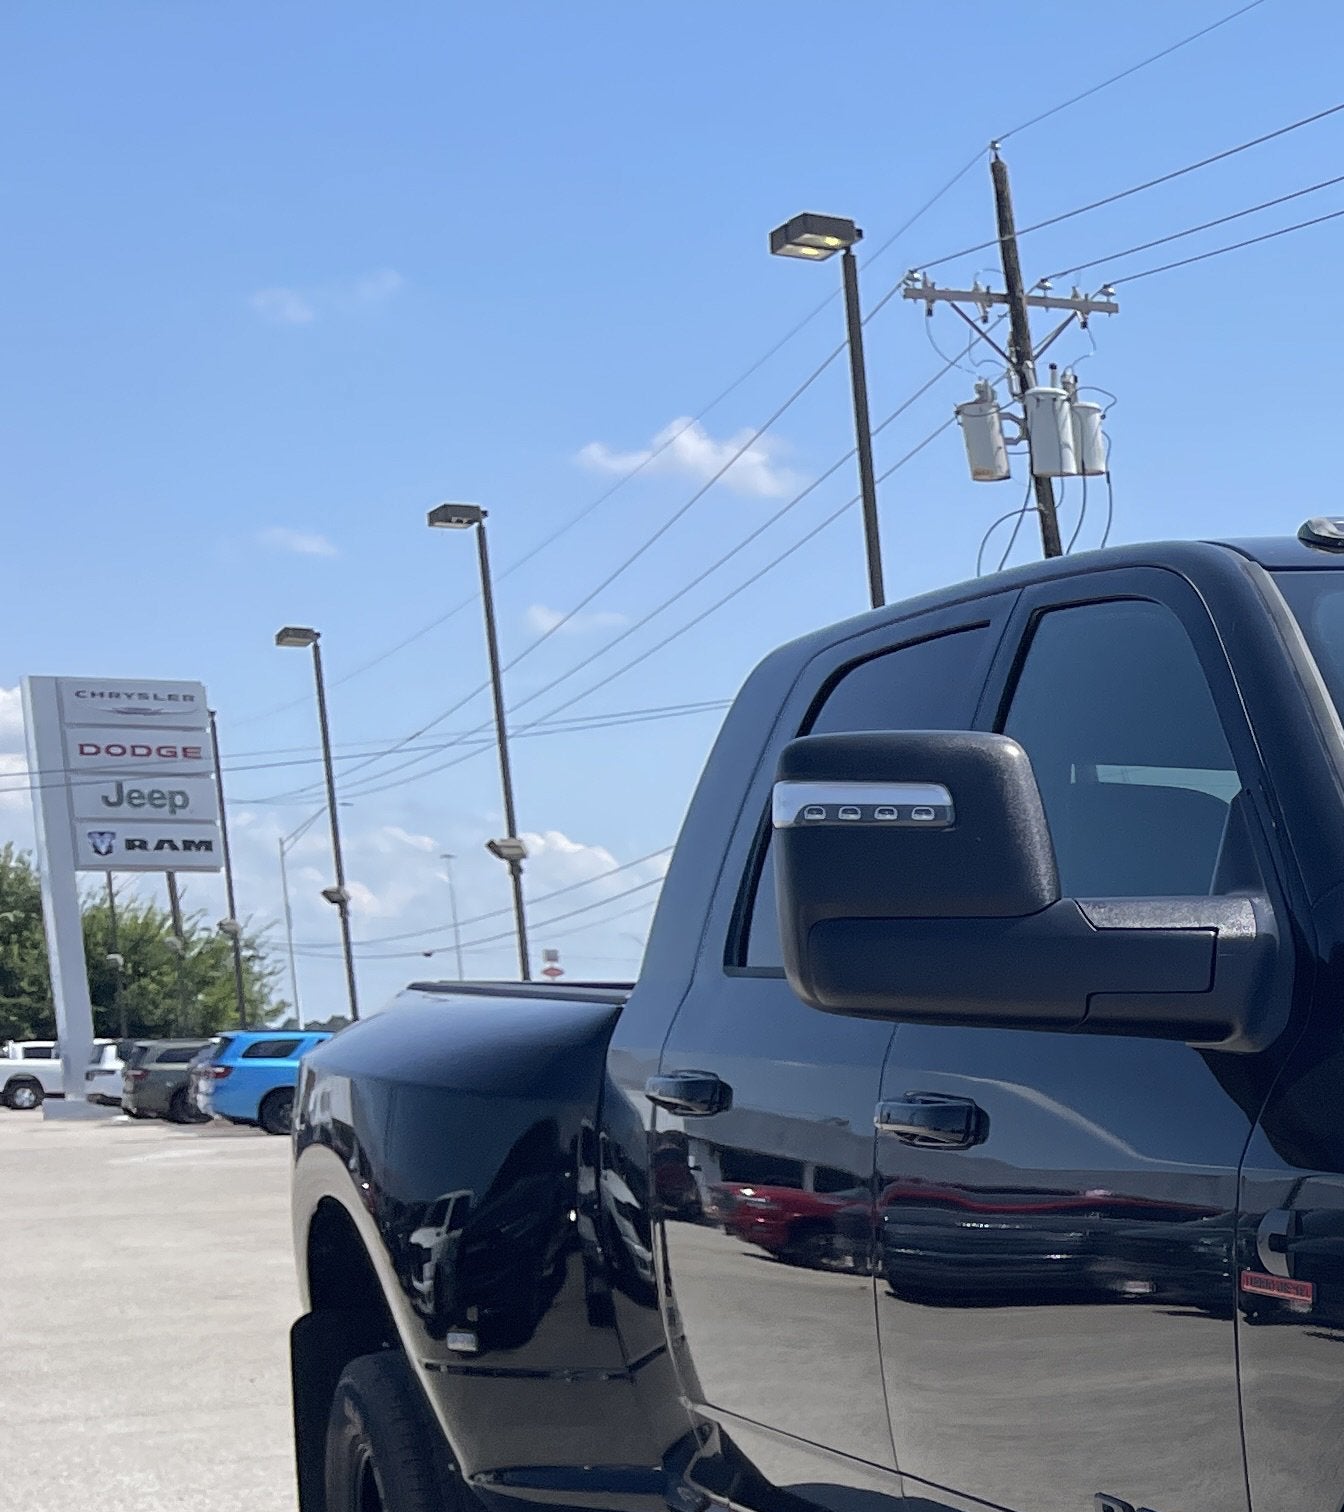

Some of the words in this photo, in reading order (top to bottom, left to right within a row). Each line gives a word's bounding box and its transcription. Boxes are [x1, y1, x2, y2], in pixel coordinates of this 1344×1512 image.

[75, 690, 195, 702] CHRYSLER
[78, 743, 202, 759] DODGE
[101, 780, 190, 815] Jeep
[124, 838, 213, 852] RAM
